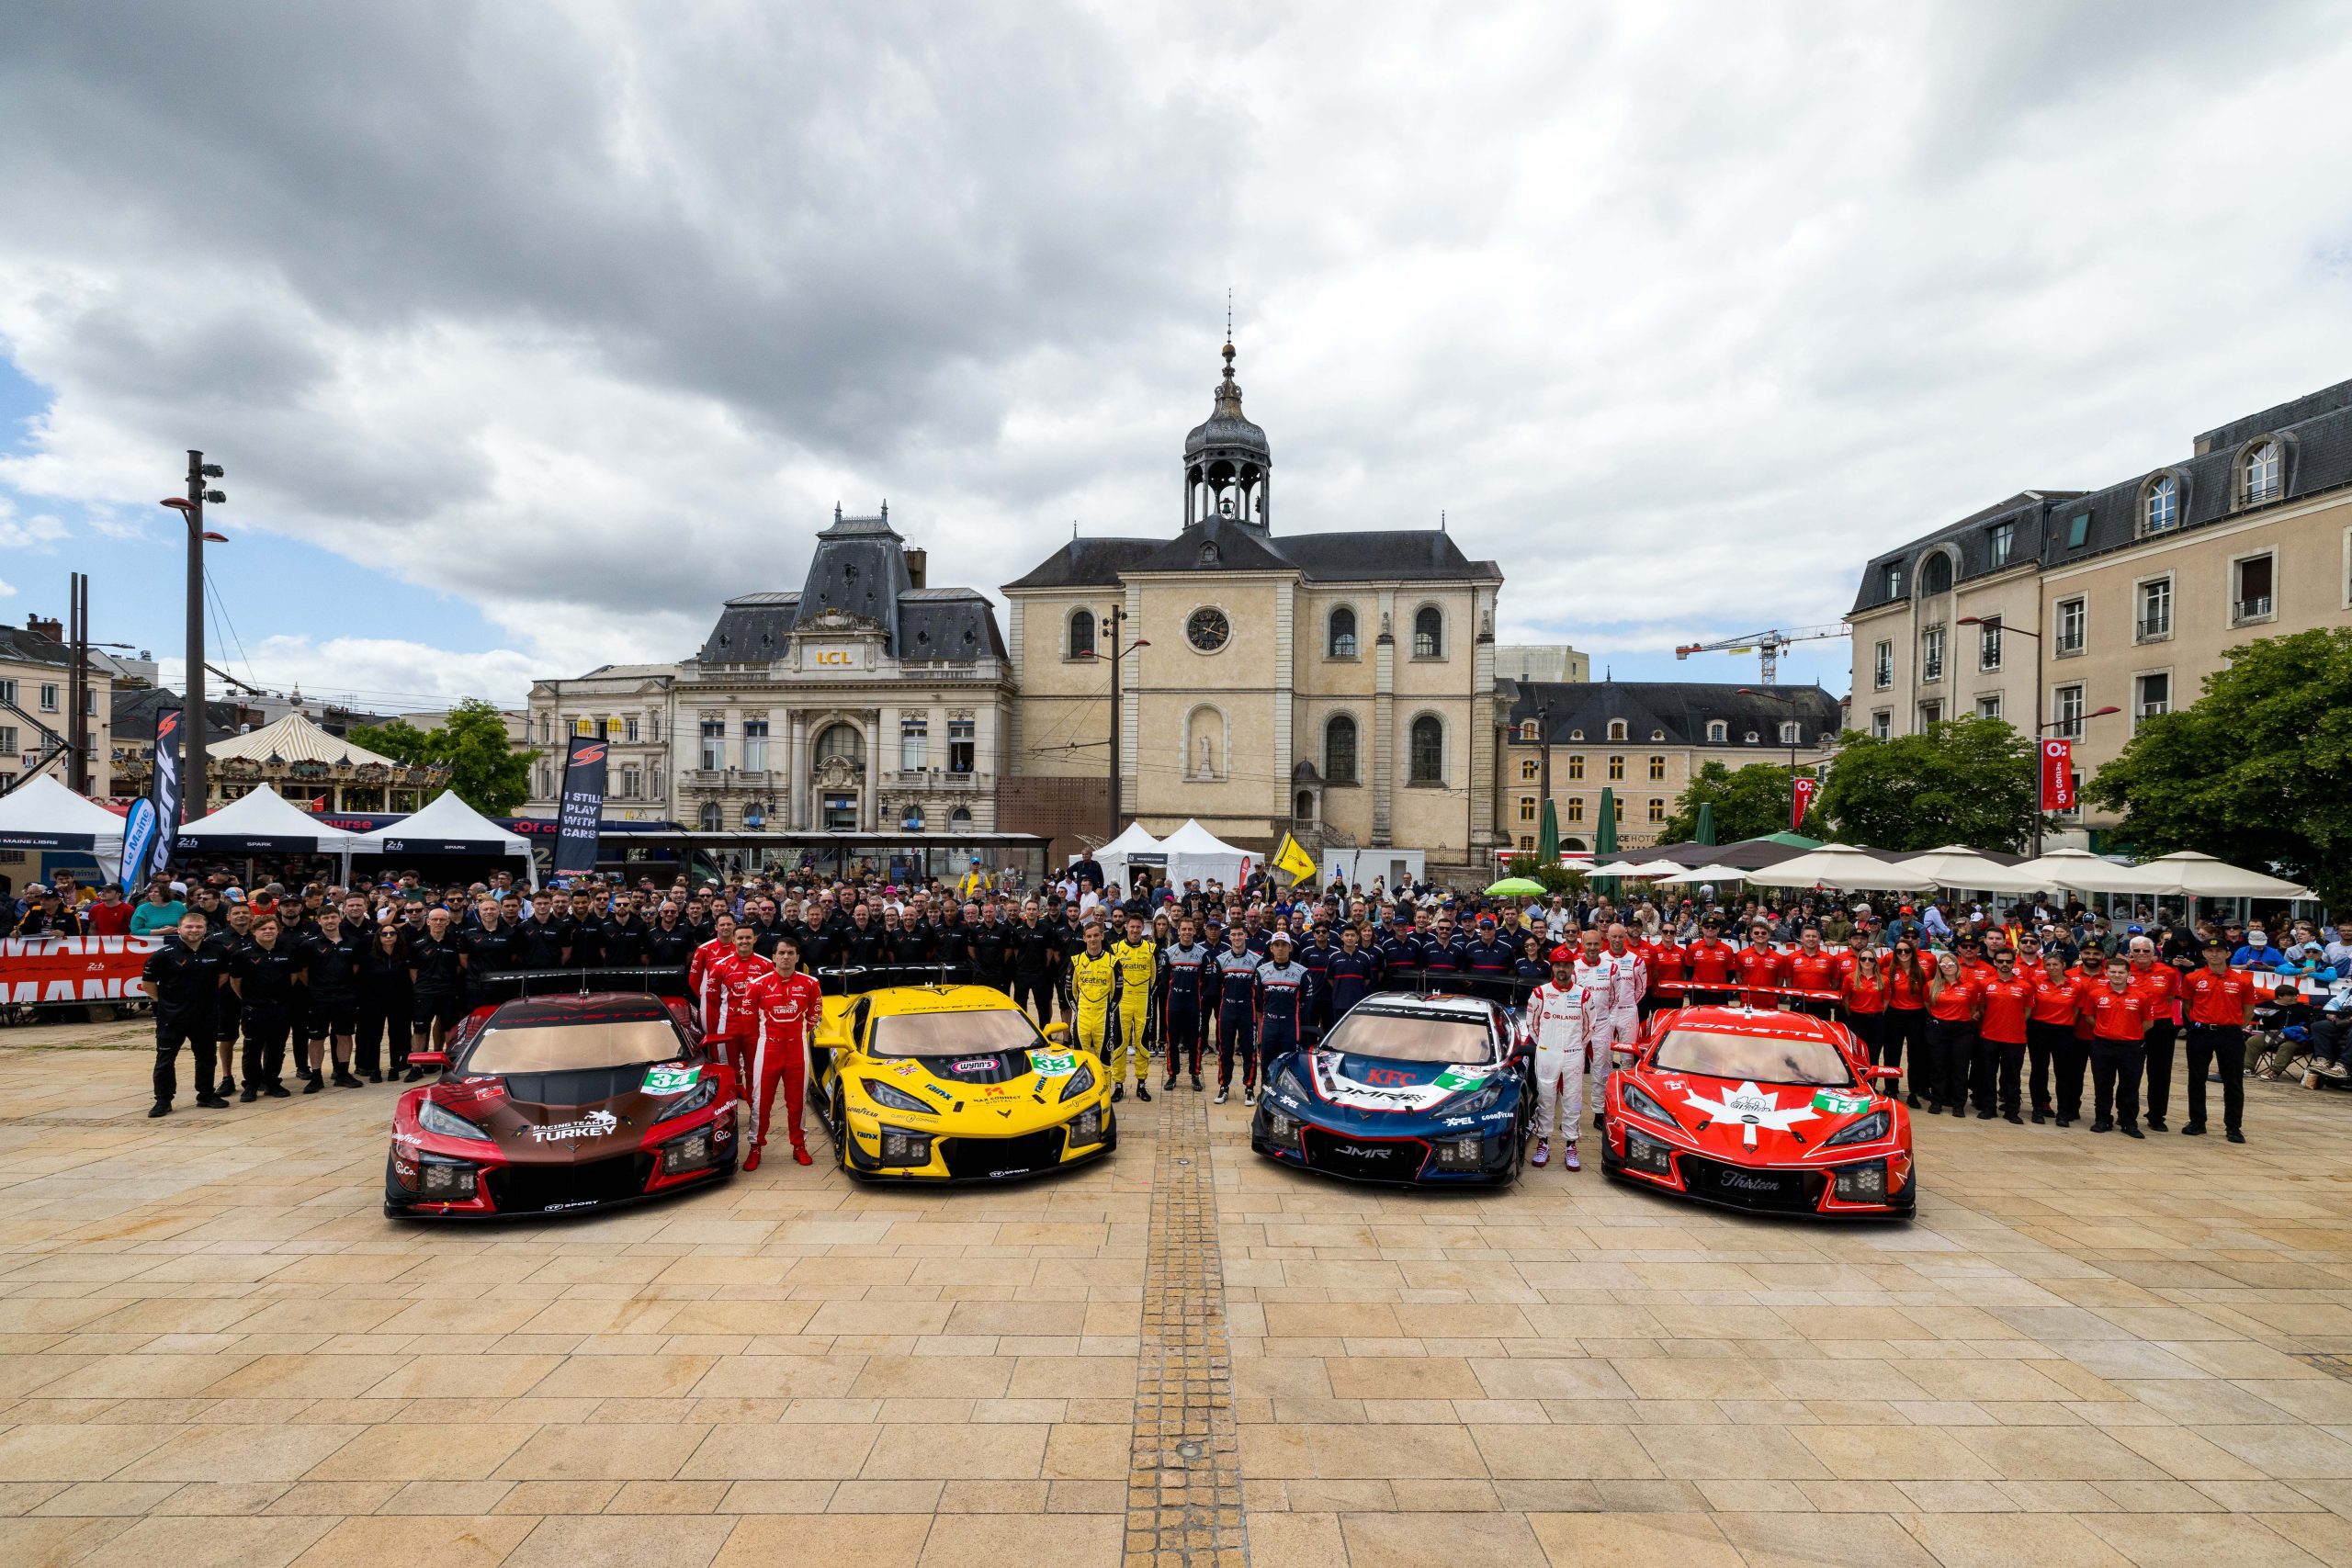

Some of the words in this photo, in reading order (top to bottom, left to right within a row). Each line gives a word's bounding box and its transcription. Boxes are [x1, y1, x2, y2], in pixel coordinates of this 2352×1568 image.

[817, 650, 853, 664] LCL
[564, 791, 569, 801] I
[572, 792, 603, 804] STILL
[566, 803, 597, 816] PLAY
[128, 808, 150, 849] Maine
[322, 819, 372, 829] ourse
[563, 815, 596, 828] WITH
[561, 828, 596, 840] CARS
[124, 852, 133, 866] Le
[1080, 976, 1107, 986] Keating
[899, 1003, 996, 1011] CORVETTE
[1355, 1006, 1487, 1021] CORVETTE
[499, 1011, 660, 1024] CORVETTE
[1678, 1022, 1824, 1039] CORVETTE
[1036, 1057, 1071, 1071] 33
[651, 1072, 690, 1088] 34
[1366, 1068, 1417, 1087] KFC
[1448, 1077, 1471, 1090] 2
[1331, 1087, 1405, 1101] JMR
[1280, 1094, 1299, 1109] XPEL
[1825, 1098, 1860, 1113] 13
[847, 1106, 879, 1118] GOODYEAR
[1481, 1111, 1514, 1121] GOODYEAR
[533, 1122, 571, 1131] RACING
[1446, 1117, 1475, 1127] XPEL
[532, 1124, 617, 1143] TURKEY
[1335, 1145, 1393, 1159] JMR
[1720, 1169, 1780, 1190] Thirteen
